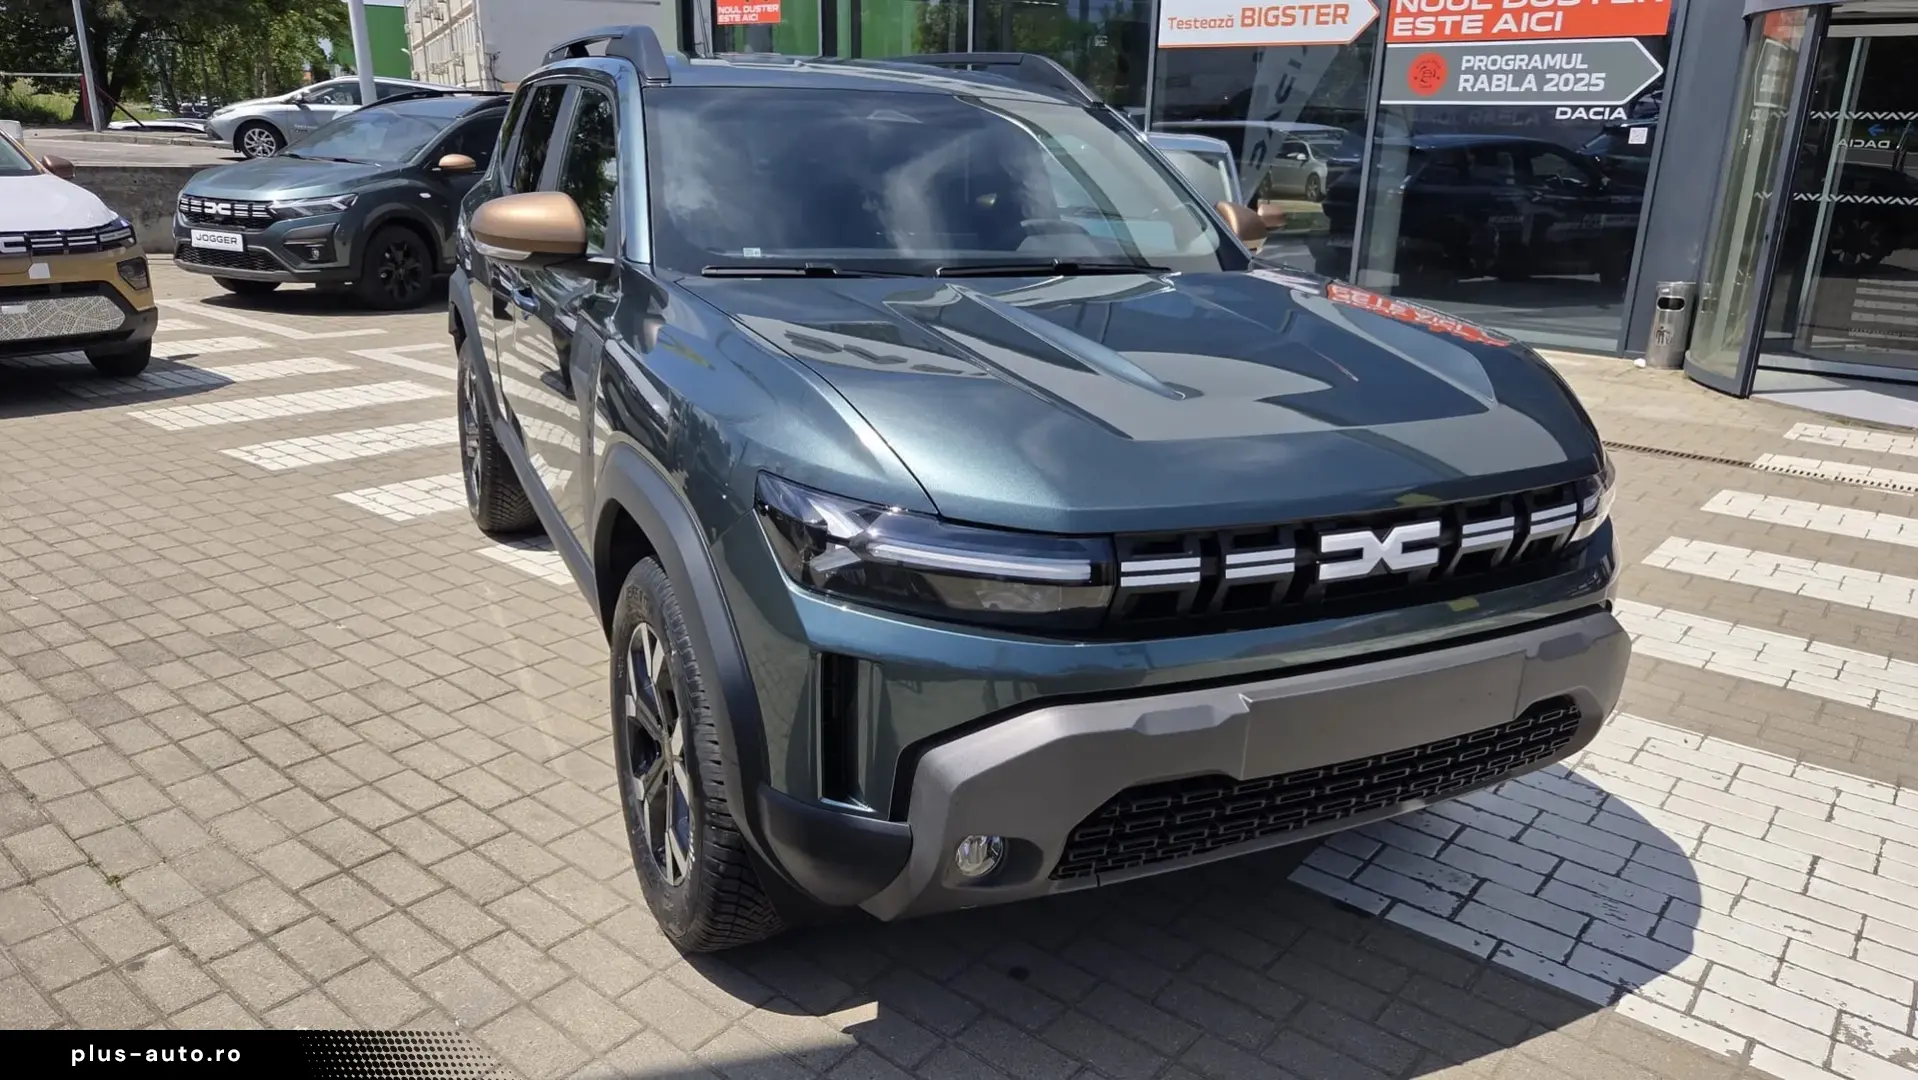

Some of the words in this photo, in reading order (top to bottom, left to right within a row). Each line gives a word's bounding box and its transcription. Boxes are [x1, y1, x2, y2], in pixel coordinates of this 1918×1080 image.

[717, 6, 742, 14] NOUL
[743, 4, 779, 13] DUSTER
[718, 14, 741, 22] ESTE
[1168, 14, 1234, 30] Testează
[1240, 4, 1350, 28] BIGSTER
[1392, 14, 1484, 37] ESTE
[1491, 11, 1563, 34] AICI
[1461, 54, 1589, 71] PROGRAMUL
[1457, 73, 1537, 92] RABLA
[1543, 73, 1606, 92] 2025
[1555, 107, 1628, 120] DACIA
[196, 233, 238, 245] JOGGER
